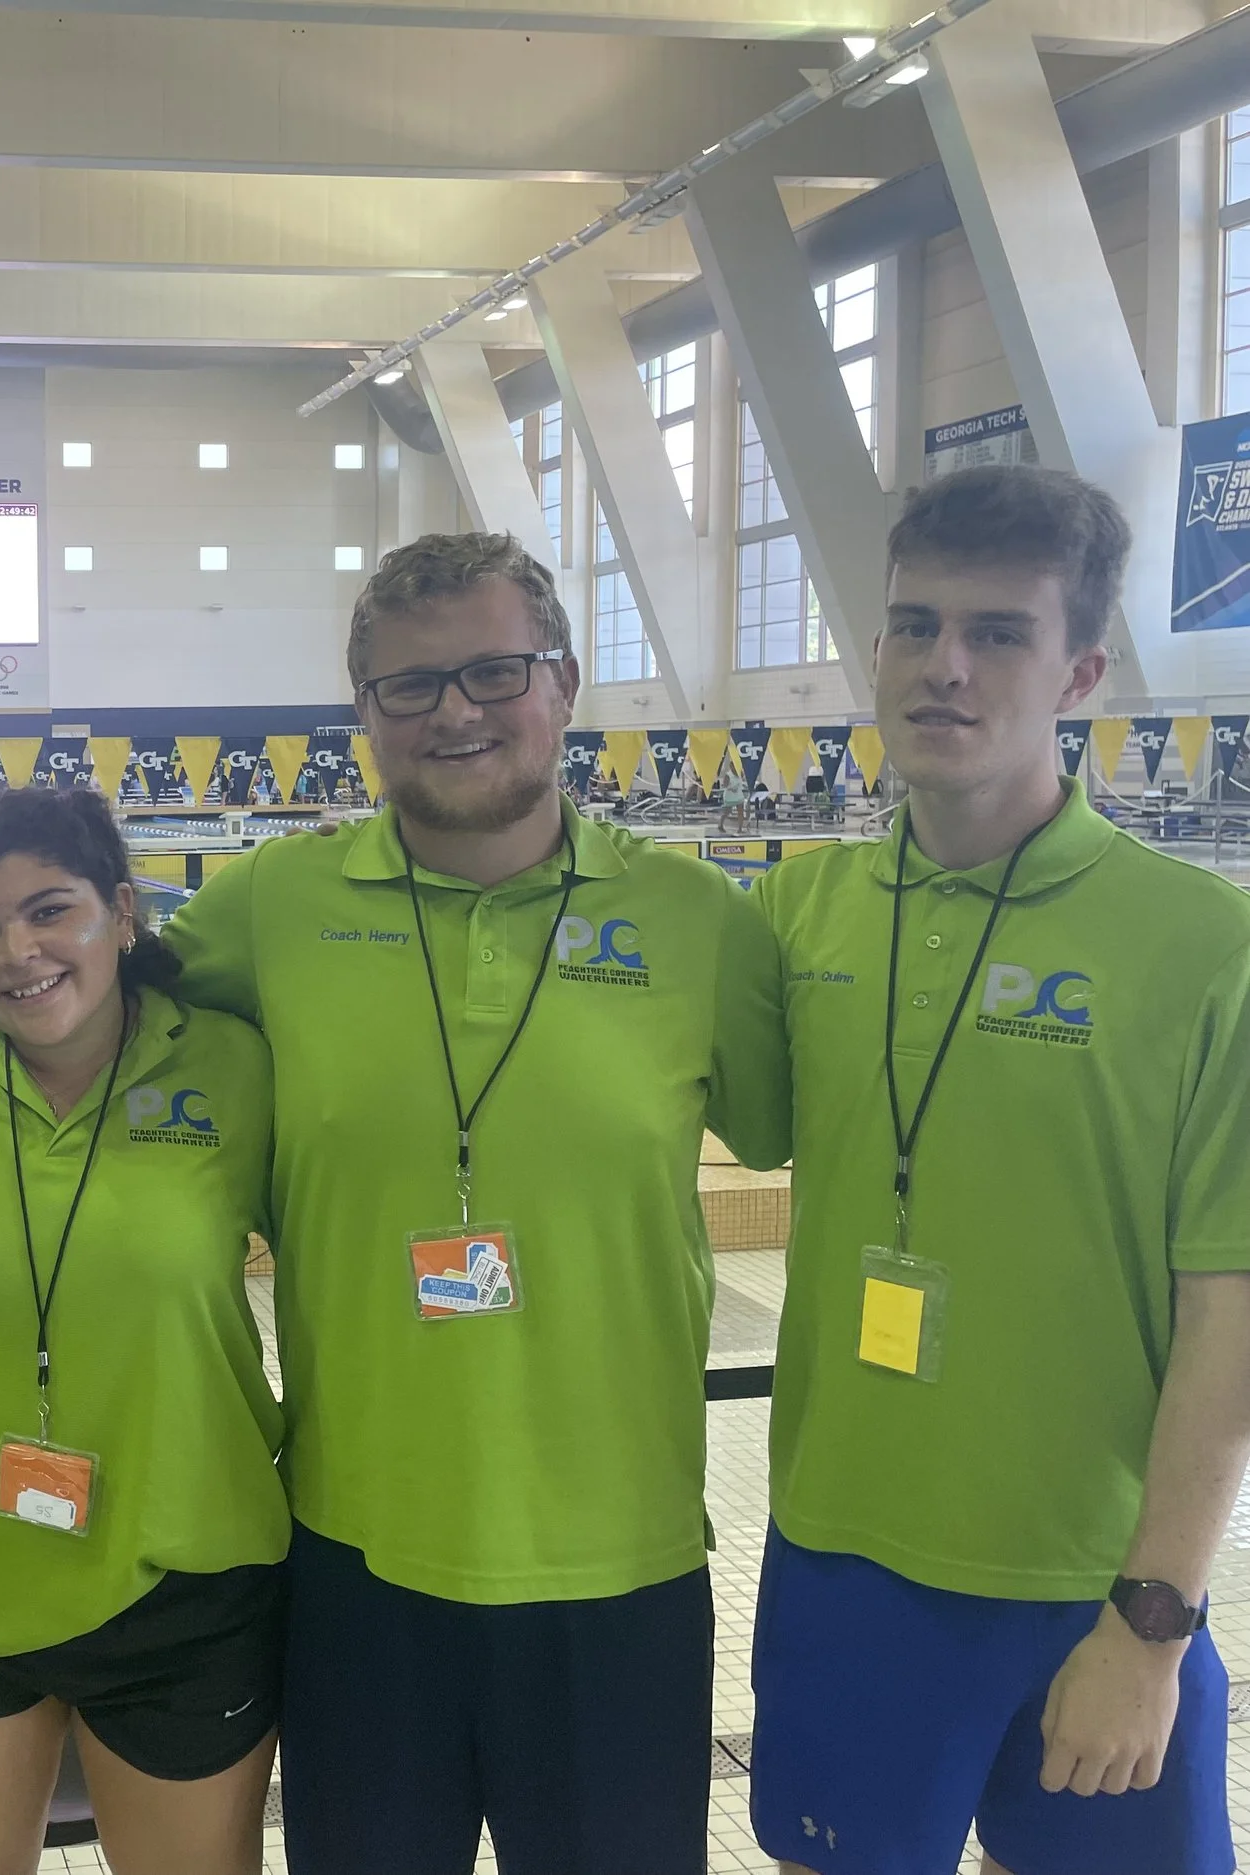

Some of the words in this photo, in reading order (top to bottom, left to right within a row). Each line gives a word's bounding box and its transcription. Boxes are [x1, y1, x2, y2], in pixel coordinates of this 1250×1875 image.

[935, 419, 984, 443] GEORGIA
[986, 409, 1016, 429] TECH
[1058, 732, 1084, 751] GT
[1139, 731, 1164, 750] GT
[1216, 726, 1241, 745] GT
[568, 745, 596, 765] GT
[651, 743, 679, 762] GT
[736, 741, 763, 760] GT
[816, 739, 843, 758] GT
[49, 752, 79, 772] GT
[139, 751, 168, 771] GT
[228, 750, 257, 770] GT
[315, 750, 343, 769] GT
[320, 929, 362, 942] Coach
[368, 929, 410, 945] Henry
[558, 963, 608, 976] PEACHTREE
[609, 969, 650, 981] CORNERS
[558, 971, 650, 988] WAVERUNNERS
[821, 971, 855, 984] Quinn
[976, 1021, 1091, 1046] WAVERUNNERS
[977, 1014, 1039, 1031] PEACHTREE
[1040, 1023, 1092, 1038] CORNERS
[129, 1128, 178, 1138] PEACHTREE
[180, 1131, 220, 1141] CORNERS
[129, 1134, 221, 1148] WAVERUNNERS
[429, 1279, 451, 1288] KEEP
[452, 1282, 471, 1292] THIS
[485, 1265, 500, 1289] ADMIT
[431, 1286, 468, 1298] COUPON
